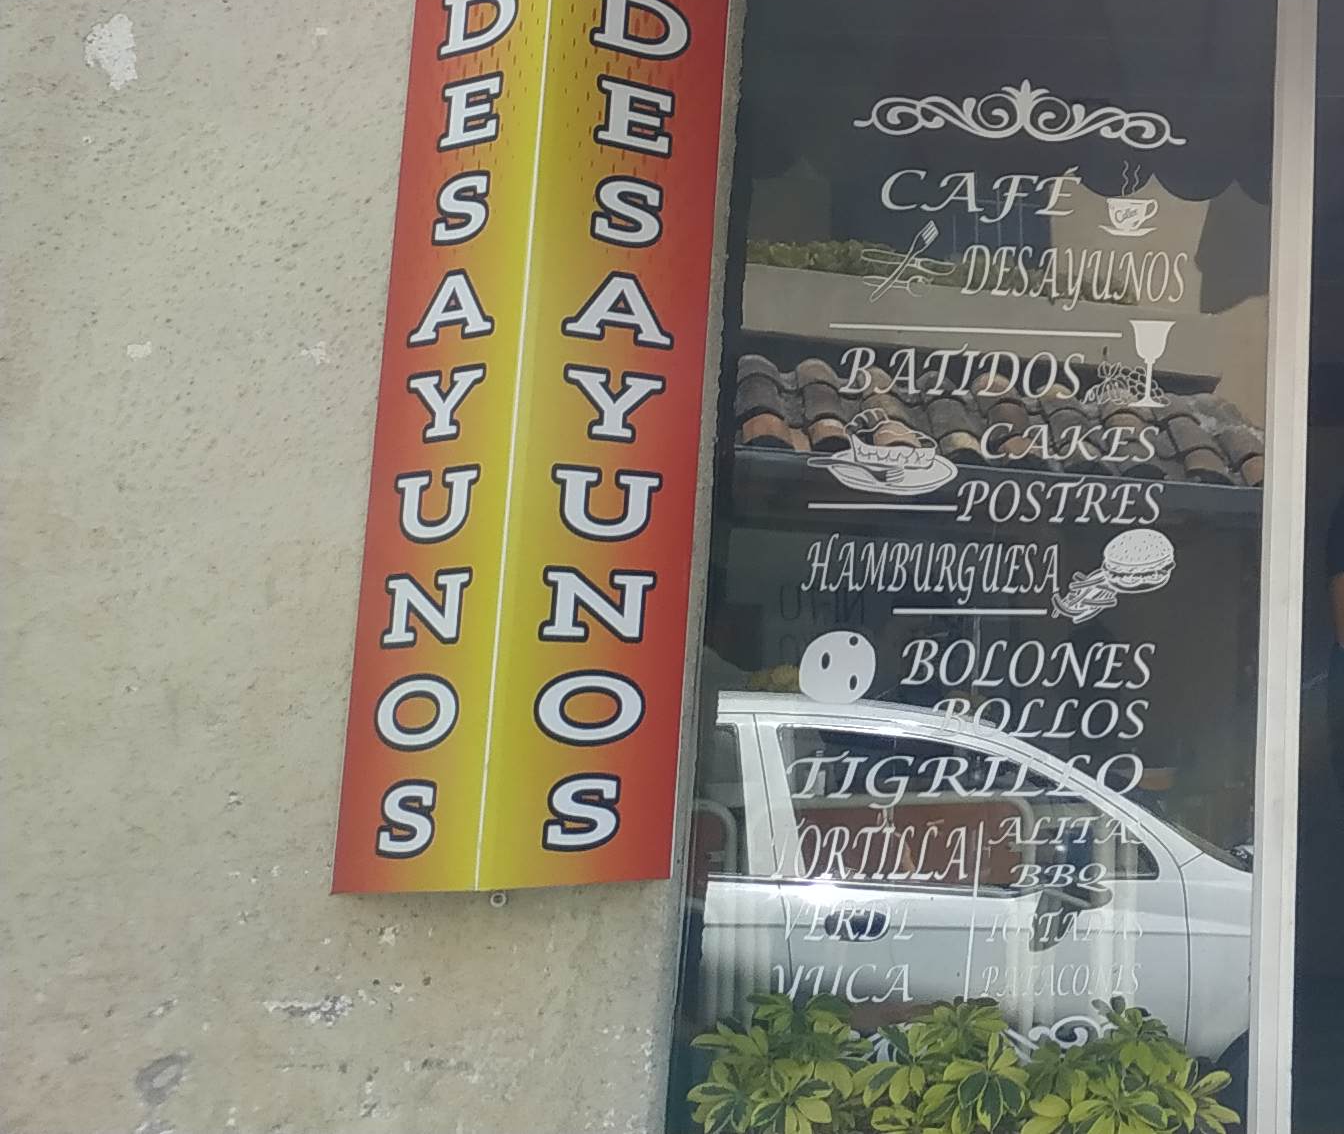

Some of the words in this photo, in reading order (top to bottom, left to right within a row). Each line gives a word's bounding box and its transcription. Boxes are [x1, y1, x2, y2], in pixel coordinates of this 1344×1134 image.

[880, 166, 1083, 223] CAFÉ
[961, 244, 1188, 311] DESAYUNOS
[838, 343, 1085, 399] BATIDOS
[980, 423, 1159, 462] CAKES
[956, 476, 1164, 524] POSTRES
[800, 533, 1060, 605] HAMBURGUESA
[900, 639, 1155, 690] BOLONES
[933, 697, 1150, 740] BOLLOS
[786, 750, 1144, 809] TIGRILLO
[1009, 863, 1109, 892] BBQ
